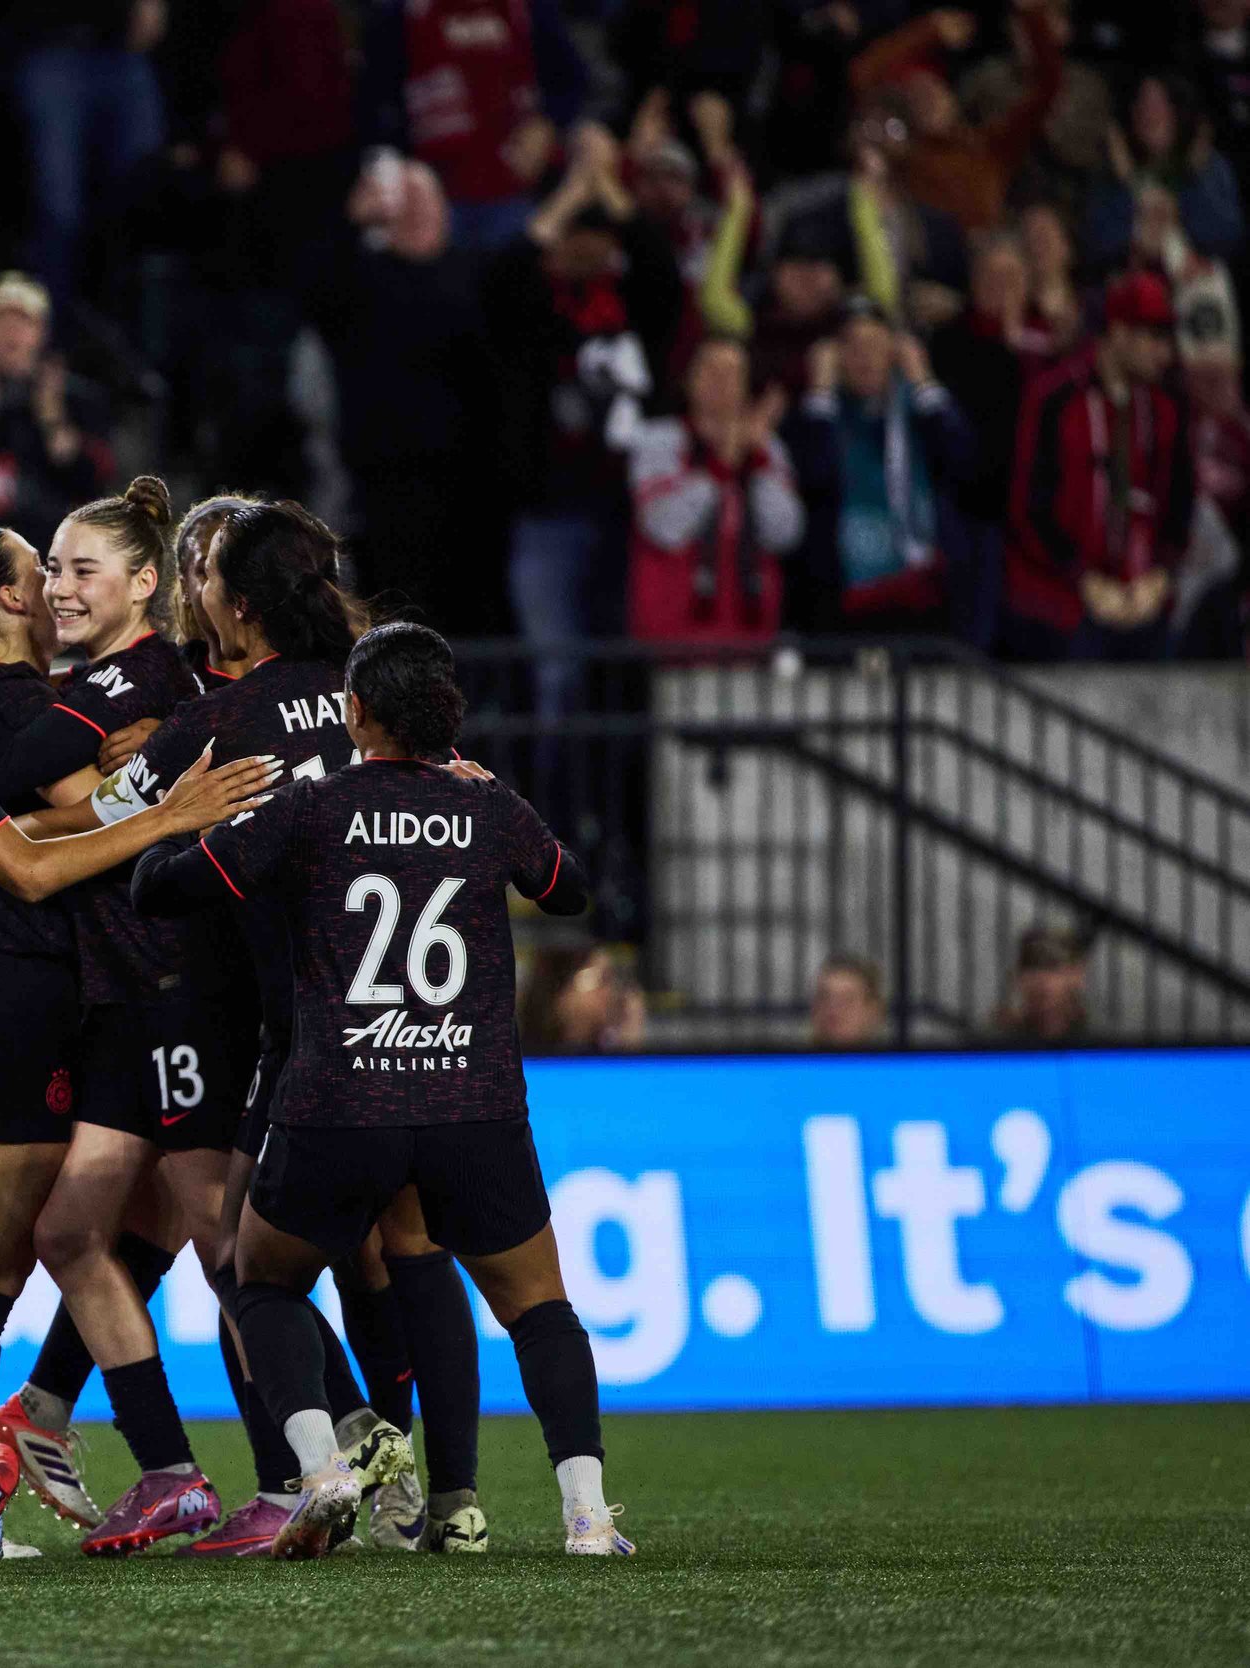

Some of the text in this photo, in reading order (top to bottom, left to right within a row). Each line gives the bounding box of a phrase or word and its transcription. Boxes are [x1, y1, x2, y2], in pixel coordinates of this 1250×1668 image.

[278, 691, 347, 733] HIAT
[344, 812, 473, 849] ALIDOU
[344, 873, 467, 1006] 26
[342, 1009, 473, 1053] Alaska
[152, 1044, 205, 1110] 13
[352, 1055, 468, 1072] AIRLINES
